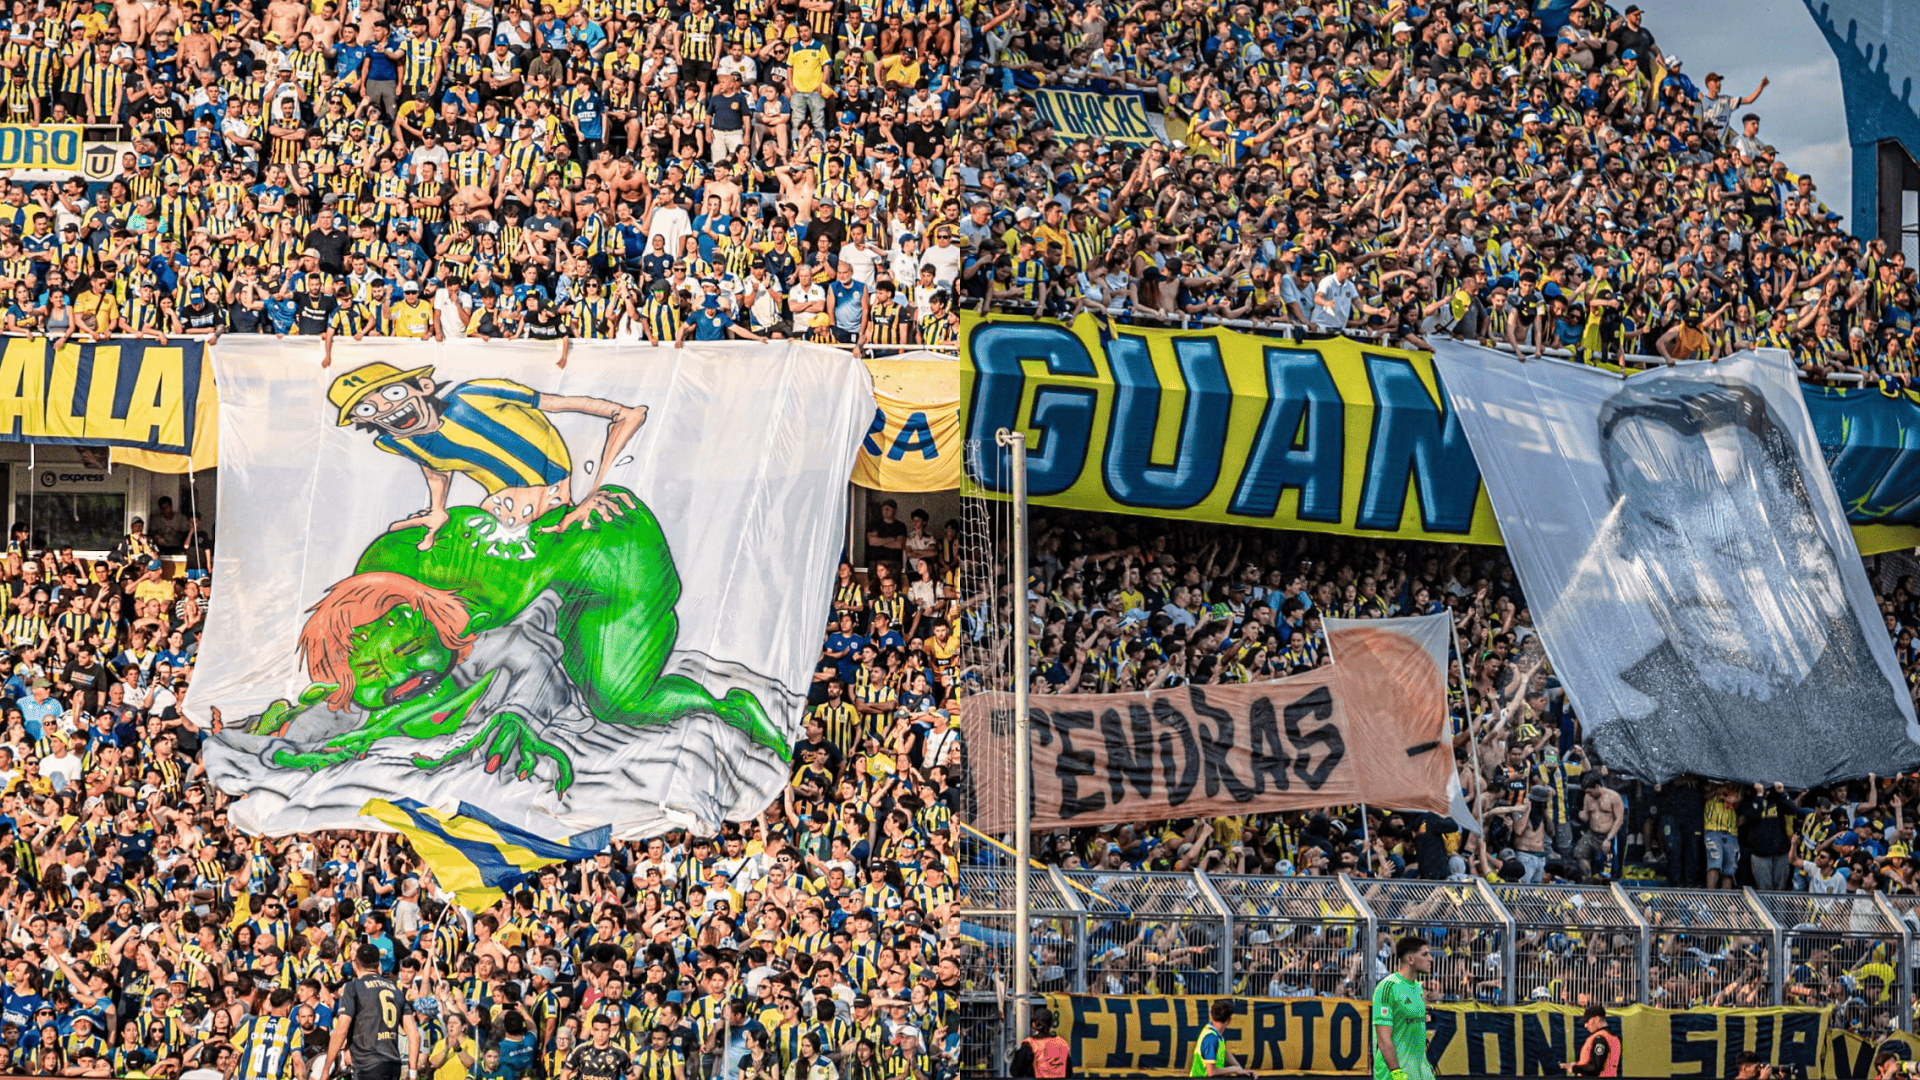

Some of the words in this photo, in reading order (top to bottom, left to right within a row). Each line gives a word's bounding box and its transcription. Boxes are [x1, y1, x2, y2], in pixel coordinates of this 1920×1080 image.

[0, 337, 185, 447] ALLA
[379, 989, 397, 1029] 6
[252, 1044, 281, 1074] 11
